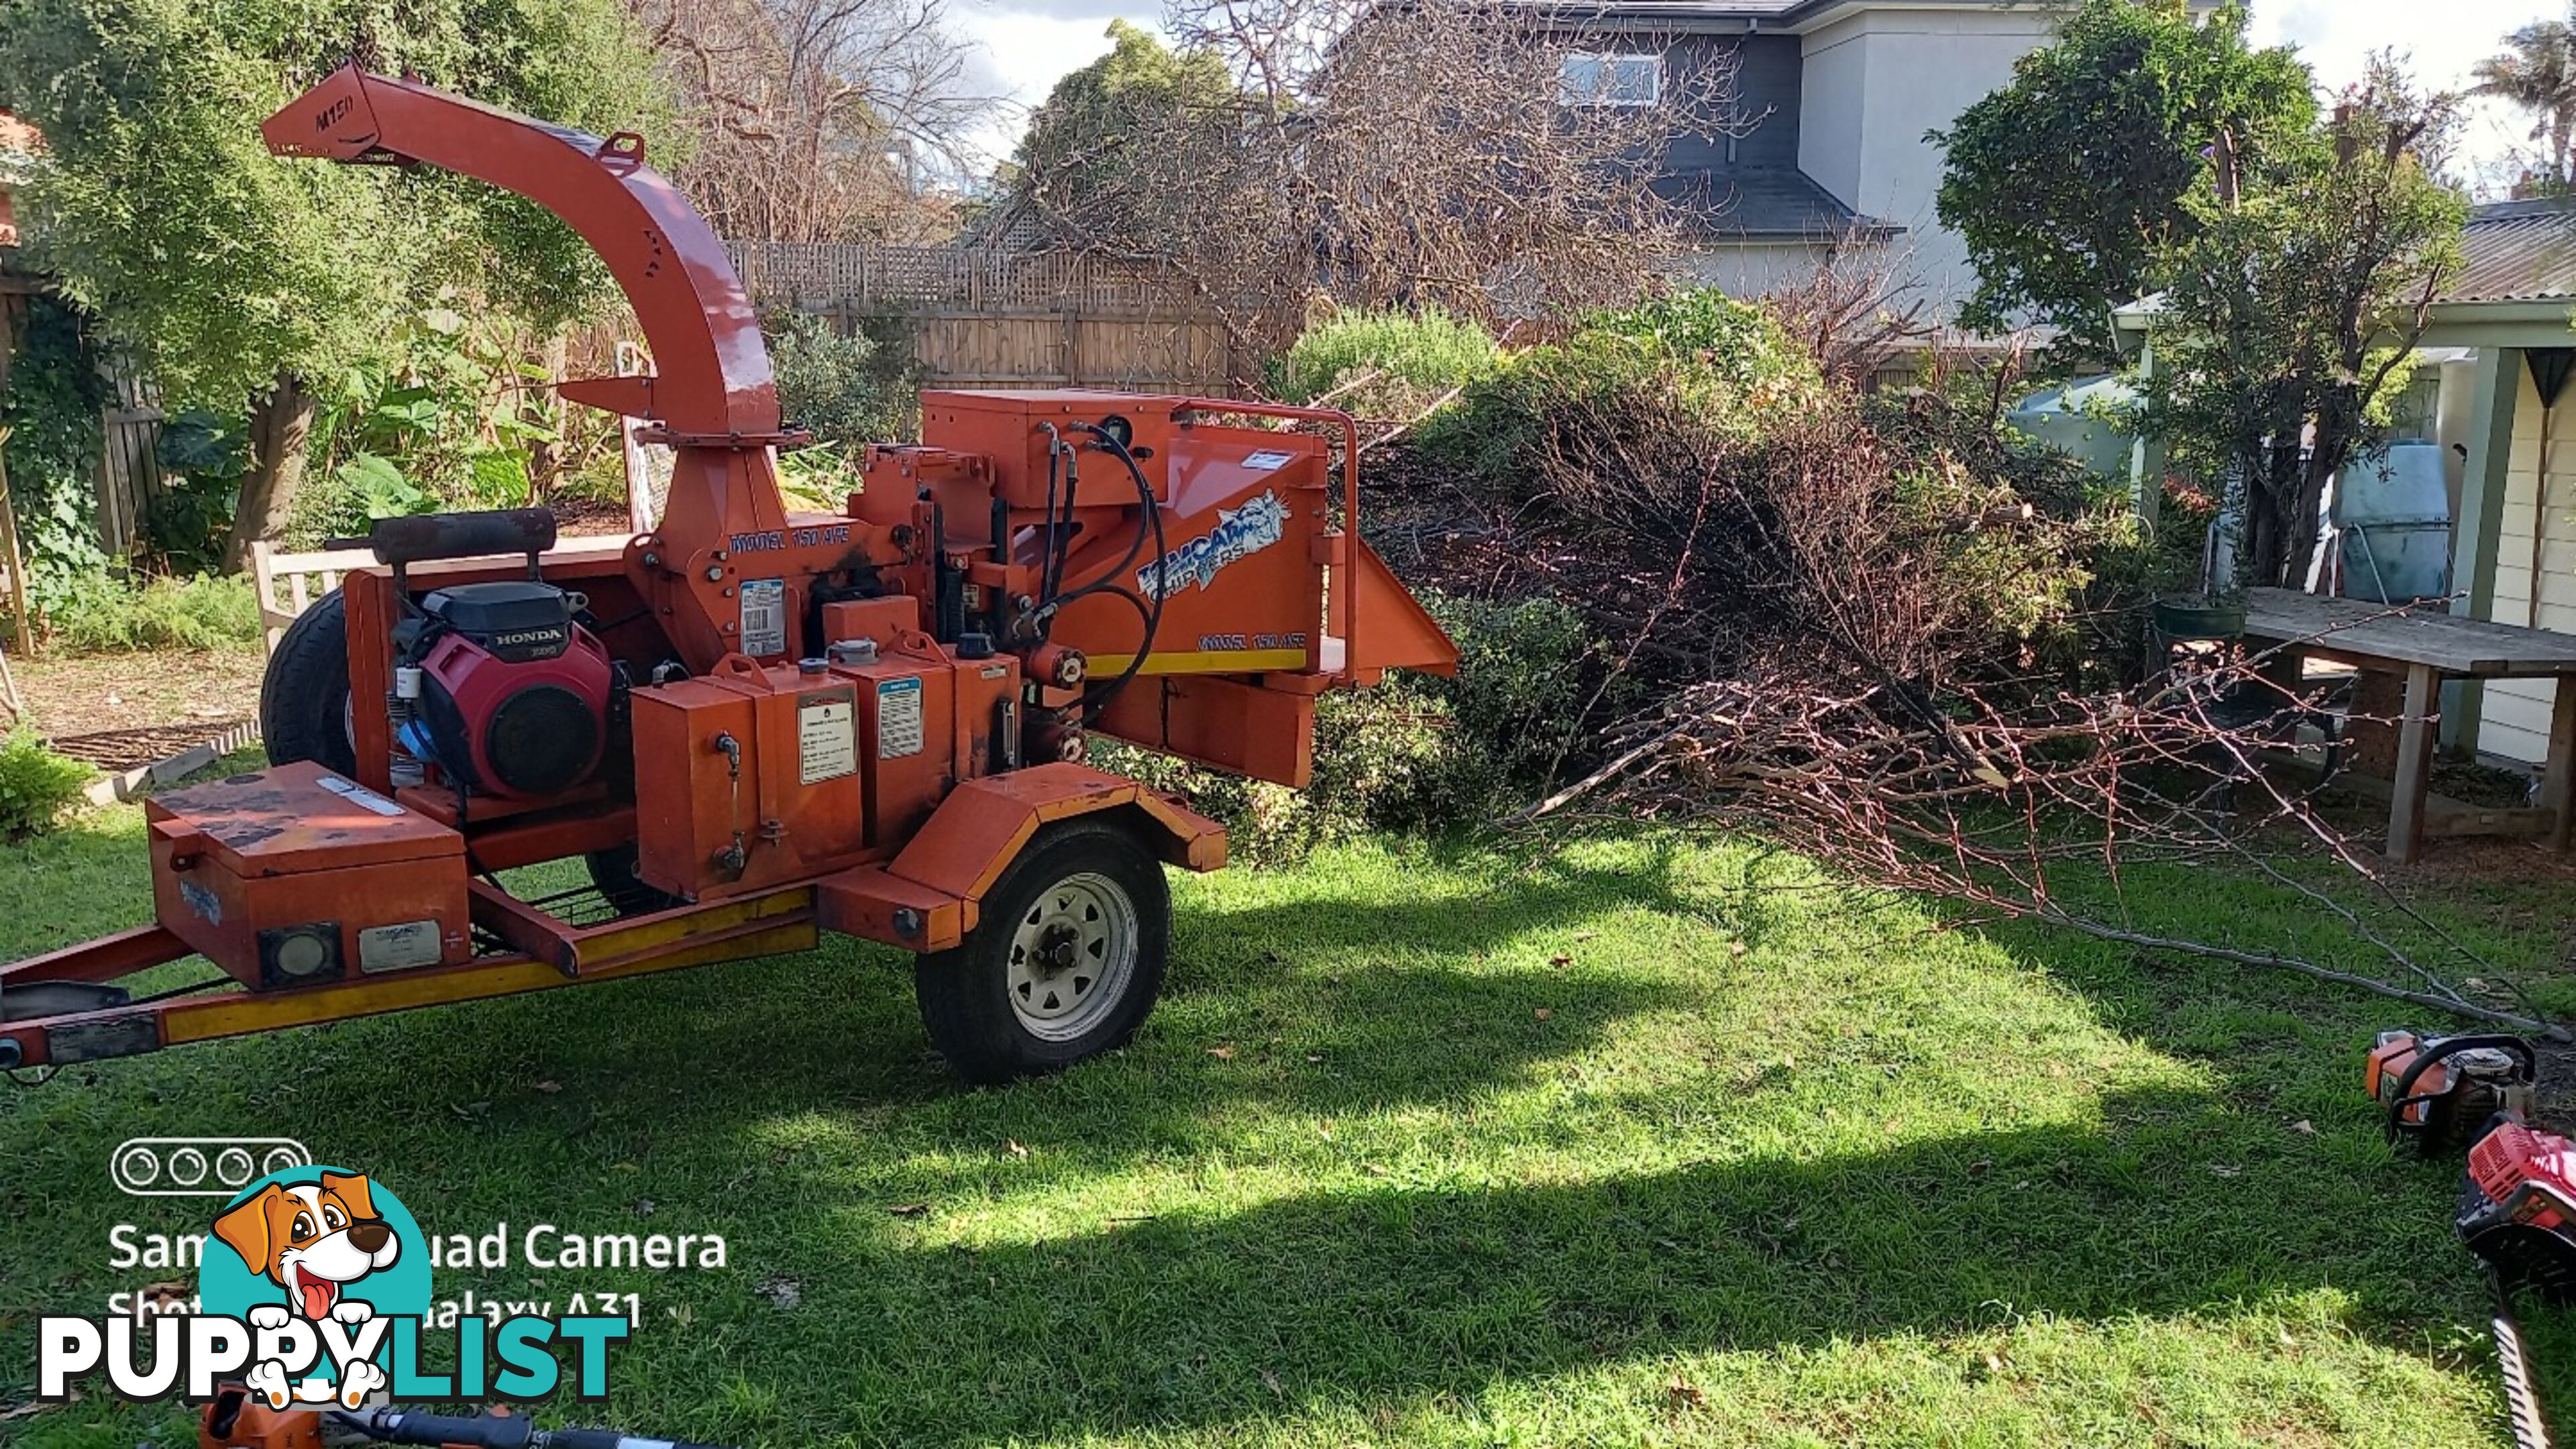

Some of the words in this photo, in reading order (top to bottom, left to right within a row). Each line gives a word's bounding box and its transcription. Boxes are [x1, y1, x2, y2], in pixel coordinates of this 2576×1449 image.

[316, 95, 353, 133] M150
[730, 532, 786, 553] MODEL
[792, 527, 820, 547] 150
[496, 629, 562, 645] HONDA
[1196, 634, 1248, 651] MODEL
[1252, 634, 1278, 649] 150
